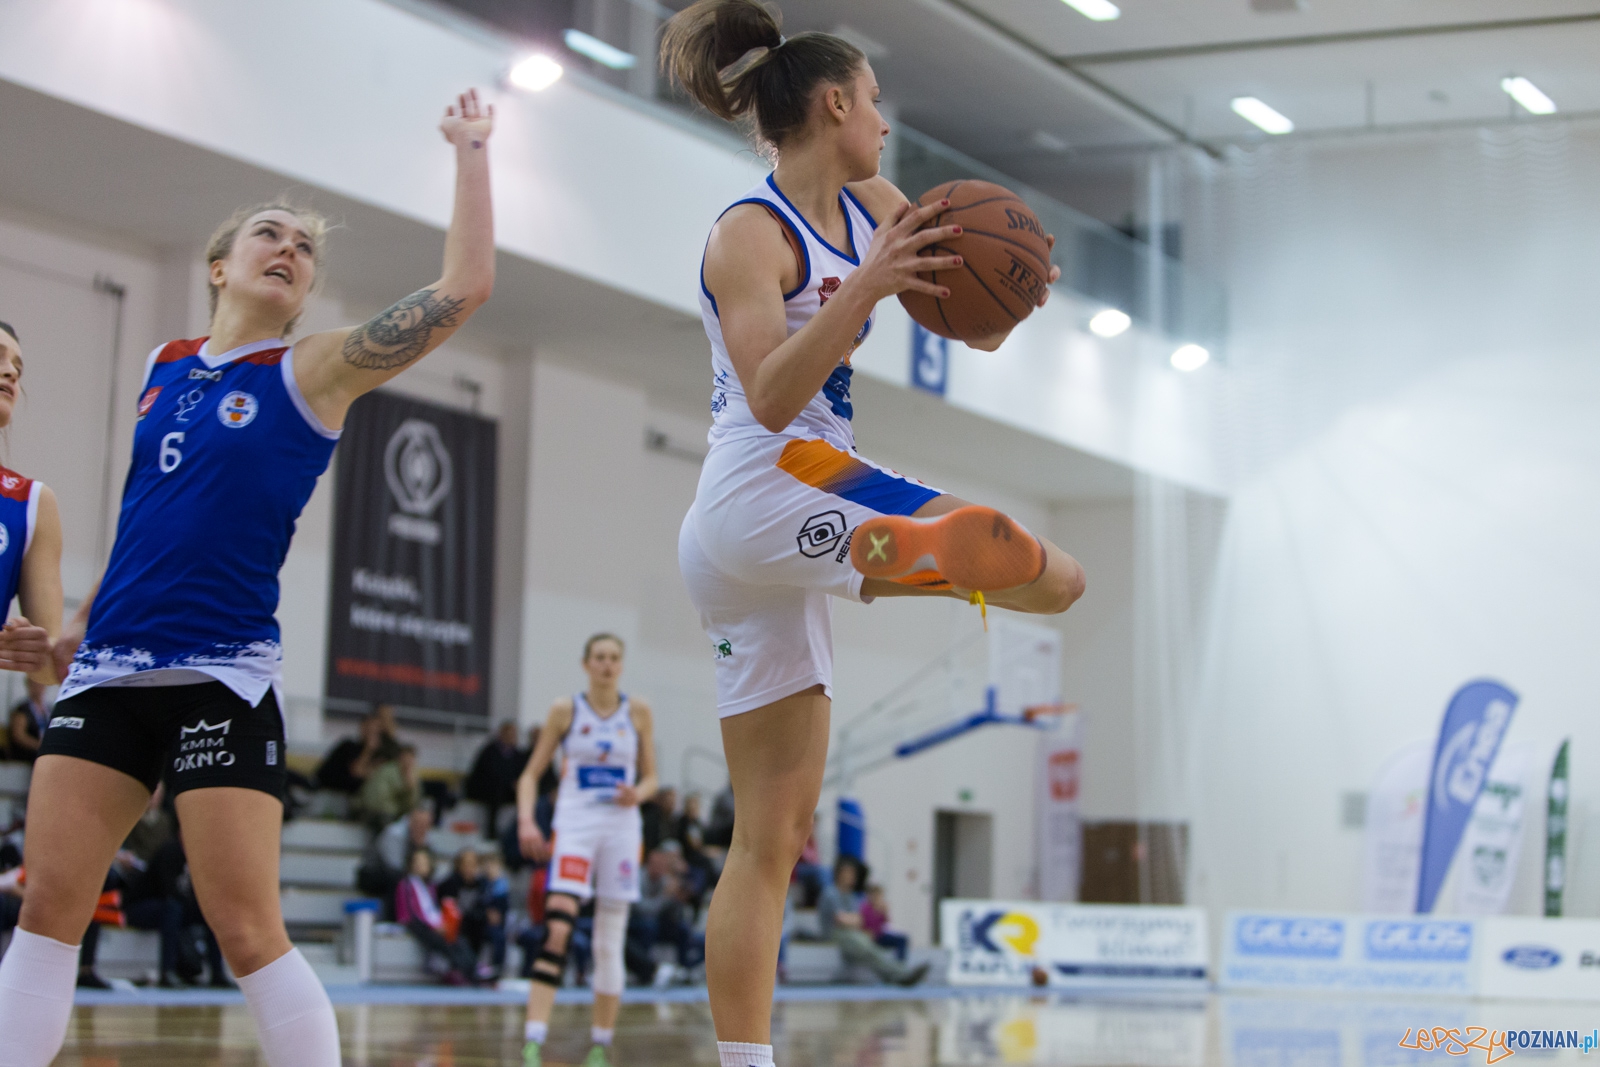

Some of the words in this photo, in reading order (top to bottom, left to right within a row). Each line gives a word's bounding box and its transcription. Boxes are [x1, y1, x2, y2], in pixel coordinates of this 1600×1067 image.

[159, 431, 185, 474] 6
[180, 737, 225, 752] KMM
[173, 750, 236, 772] OKNO
